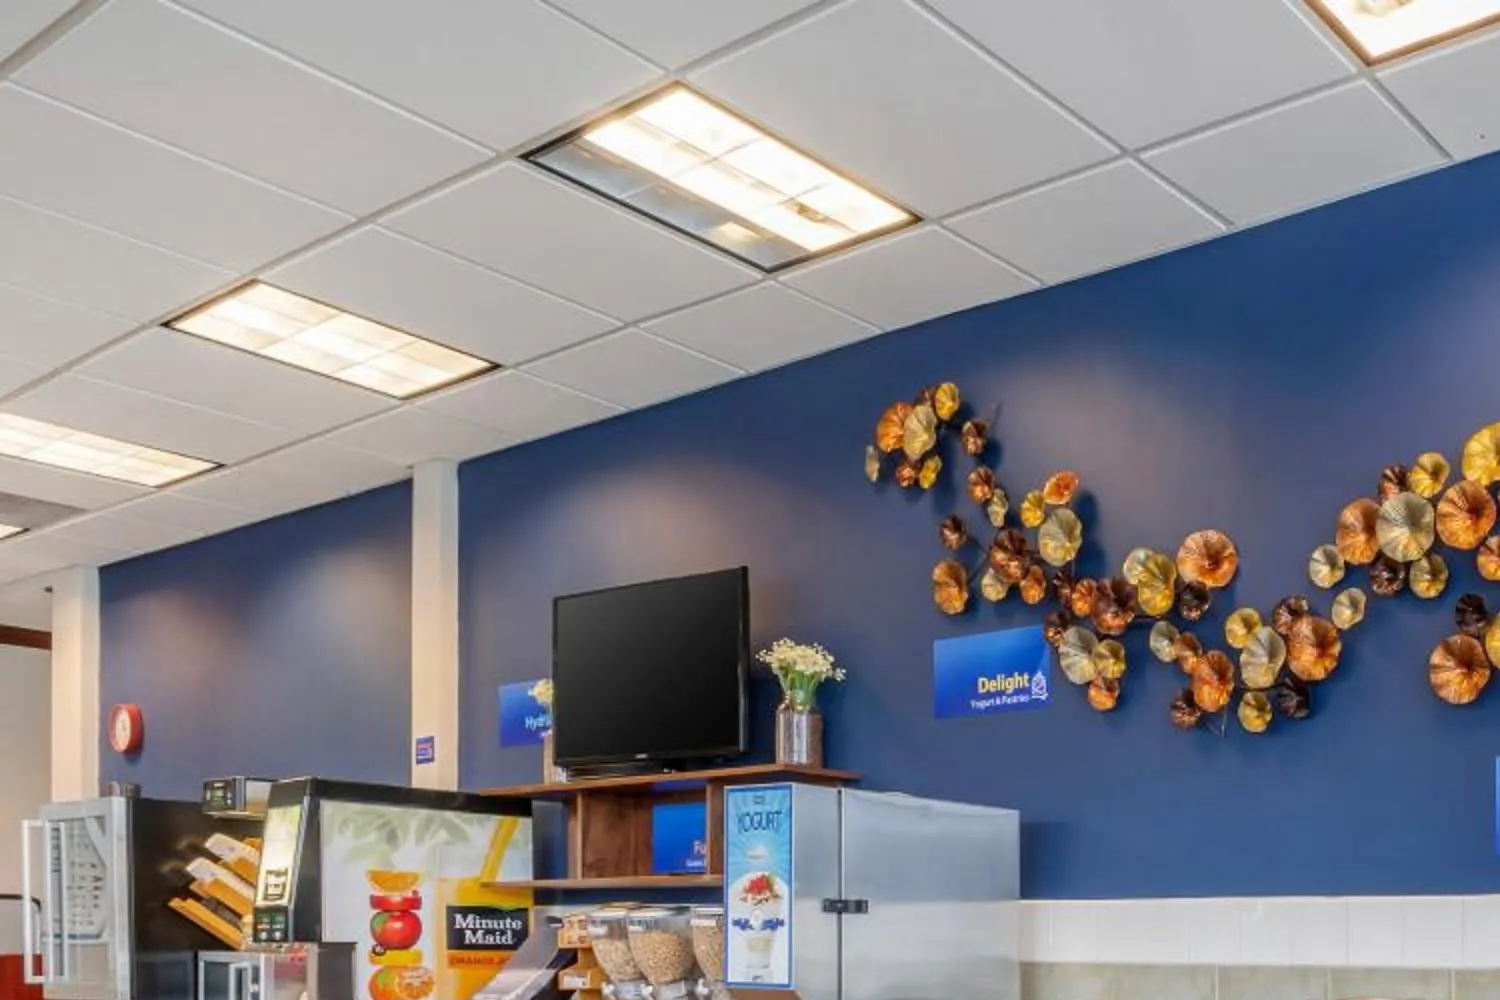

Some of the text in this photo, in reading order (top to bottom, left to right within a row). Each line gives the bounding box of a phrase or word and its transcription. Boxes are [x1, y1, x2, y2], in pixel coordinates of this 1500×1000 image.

[978, 671, 1030, 694] Delight
[737, 808, 782, 835] YOGURT
[453, 913, 523, 930] Minute
[464, 929, 513, 945] Maid
